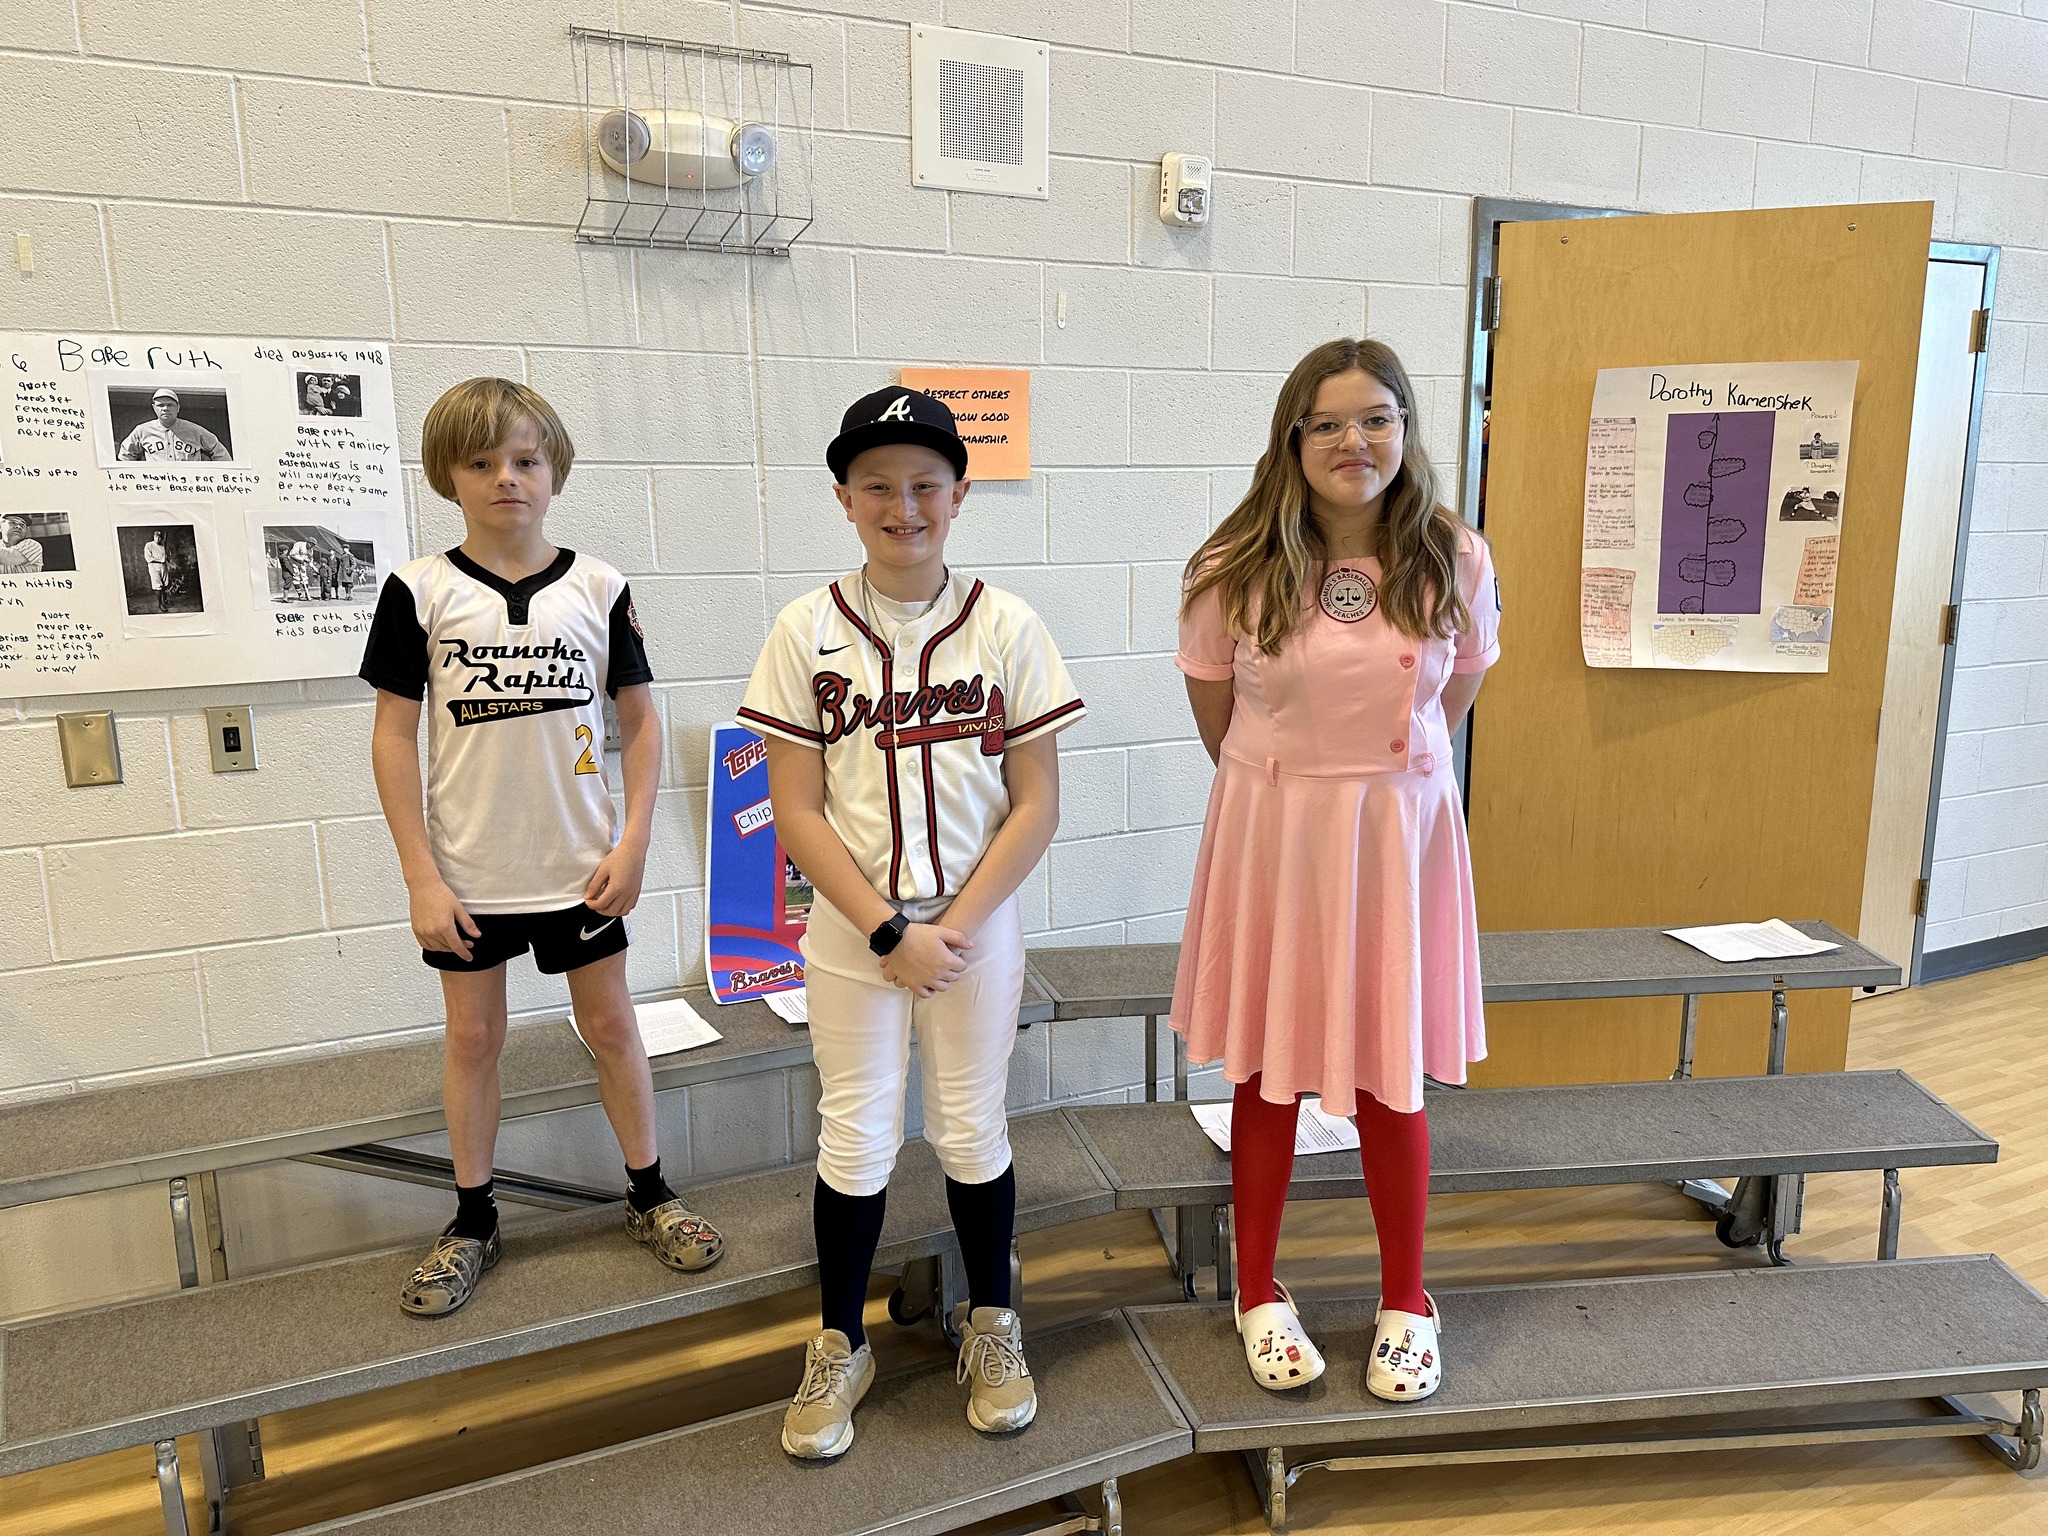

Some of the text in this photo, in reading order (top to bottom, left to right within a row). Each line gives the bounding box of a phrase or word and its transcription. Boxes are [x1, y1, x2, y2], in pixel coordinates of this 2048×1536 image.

[147, 346, 223, 370] ruth
[254, 346, 284, 362] died
[292, 349, 332, 359] august
[355, 349, 383, 365] 1948
[18, 381, 57, 391] quote
[1649, 373, 1813, 411] Dorothy Kamenshek
[971, 390, 1011, 400] OTHERS
[981, 412, 1010, 422] GOOD
[17, 428, 82, 442] never die
[323, 427, 355, 438] ruth
[958, 434, 1009, 445] MANSHIP.
[5, 466, 41, 477] going
[349, 460, 360, 471] is
[278, 469, 301, 479] will
[108, 483, 128, 492] the
[298, 483, 320, 491] the
[278, 492, 290, 502] in
[321, 497, 351, 507] world
[0, 576, 73, 590] th hitting
[1322, 577, 1337, 609] WOMEN'S
[1336, 573, 1369, 587] BASEBALL
[313, 612, 343, 622] ruth
[1332, 609, 1365, 619] PEACHES
[36, 622, 93, 632] never let
[36, 641, 94, 652] striking
[438, 637, 587, 668] Roanoke
[463, 663, 594, 695] Rapids
[461, 701, 544, 722] ALLSTARS
[813, 671, 984, 745] Braves
[574, 723, 600, 776] 2
[738, 806, 772, 829] Chip
[730, 961, 793, 993] Braves
